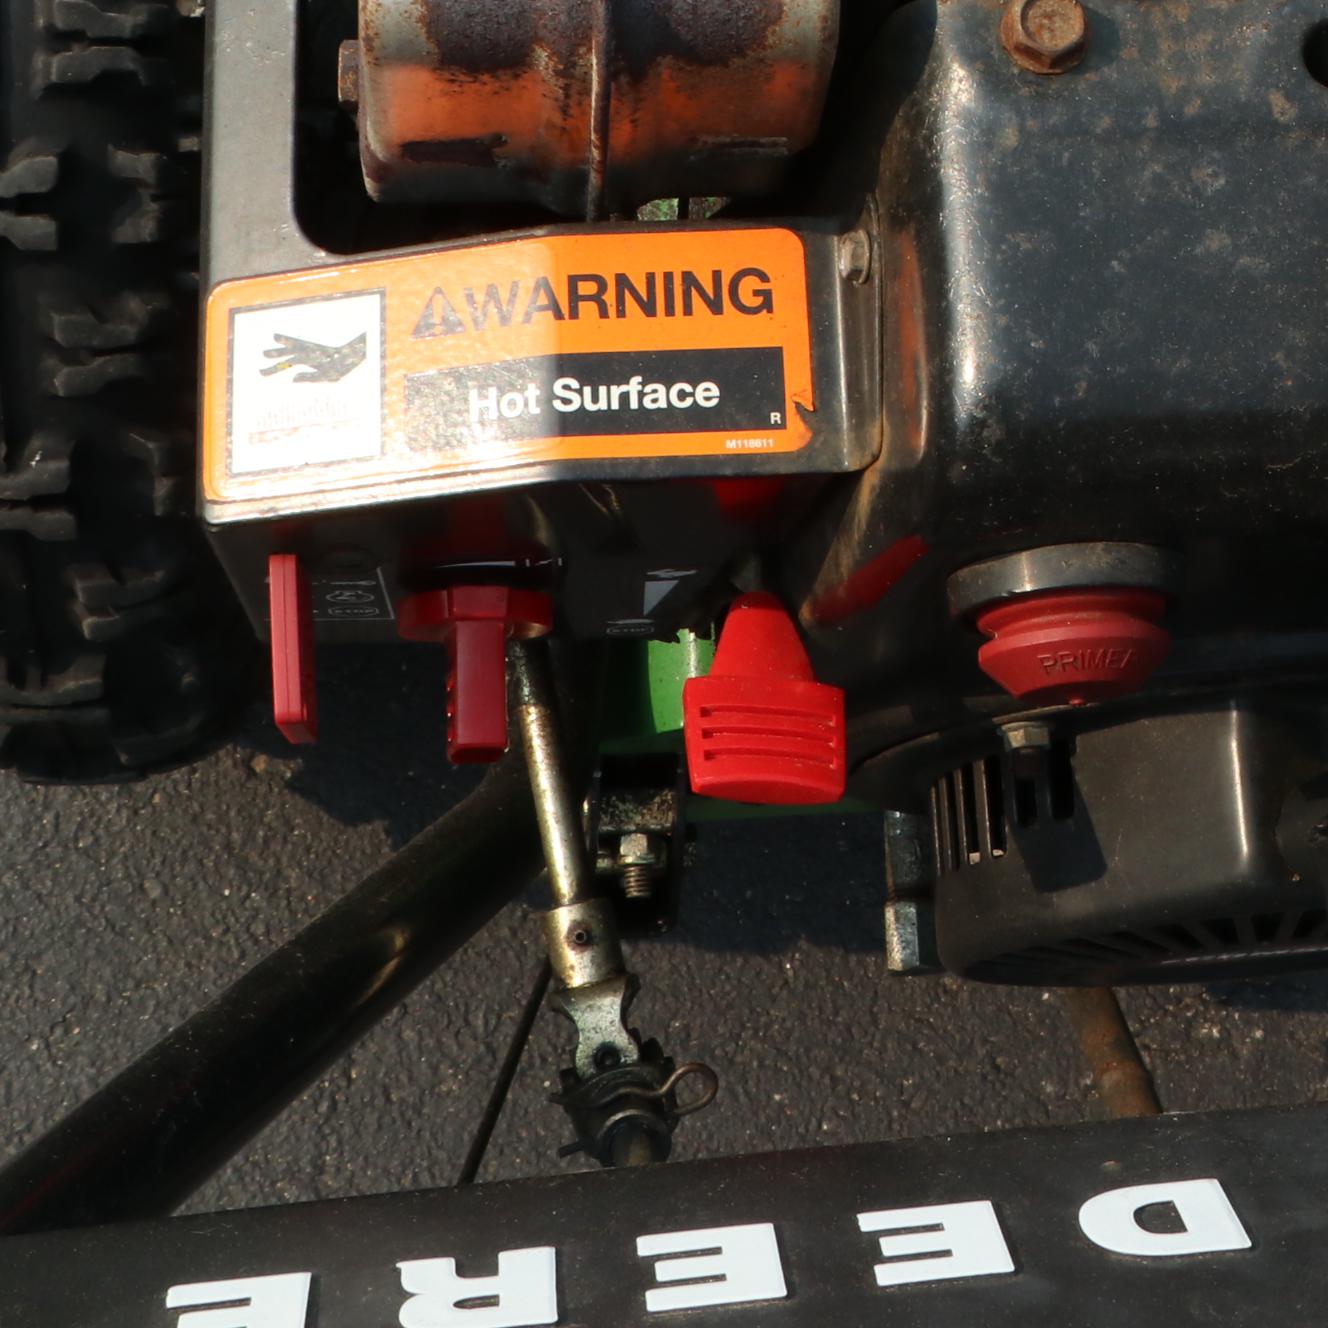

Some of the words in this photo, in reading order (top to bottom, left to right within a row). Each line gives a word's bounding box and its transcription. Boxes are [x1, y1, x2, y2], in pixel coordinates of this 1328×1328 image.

[463, 267, 774, 332] WARNING
[468, 382, 540, 423] Hot
[552, 376, 720, 413] Surface
[770, 411, 782, 425] R
[166, 1178, 1253, 1328] DEERE
